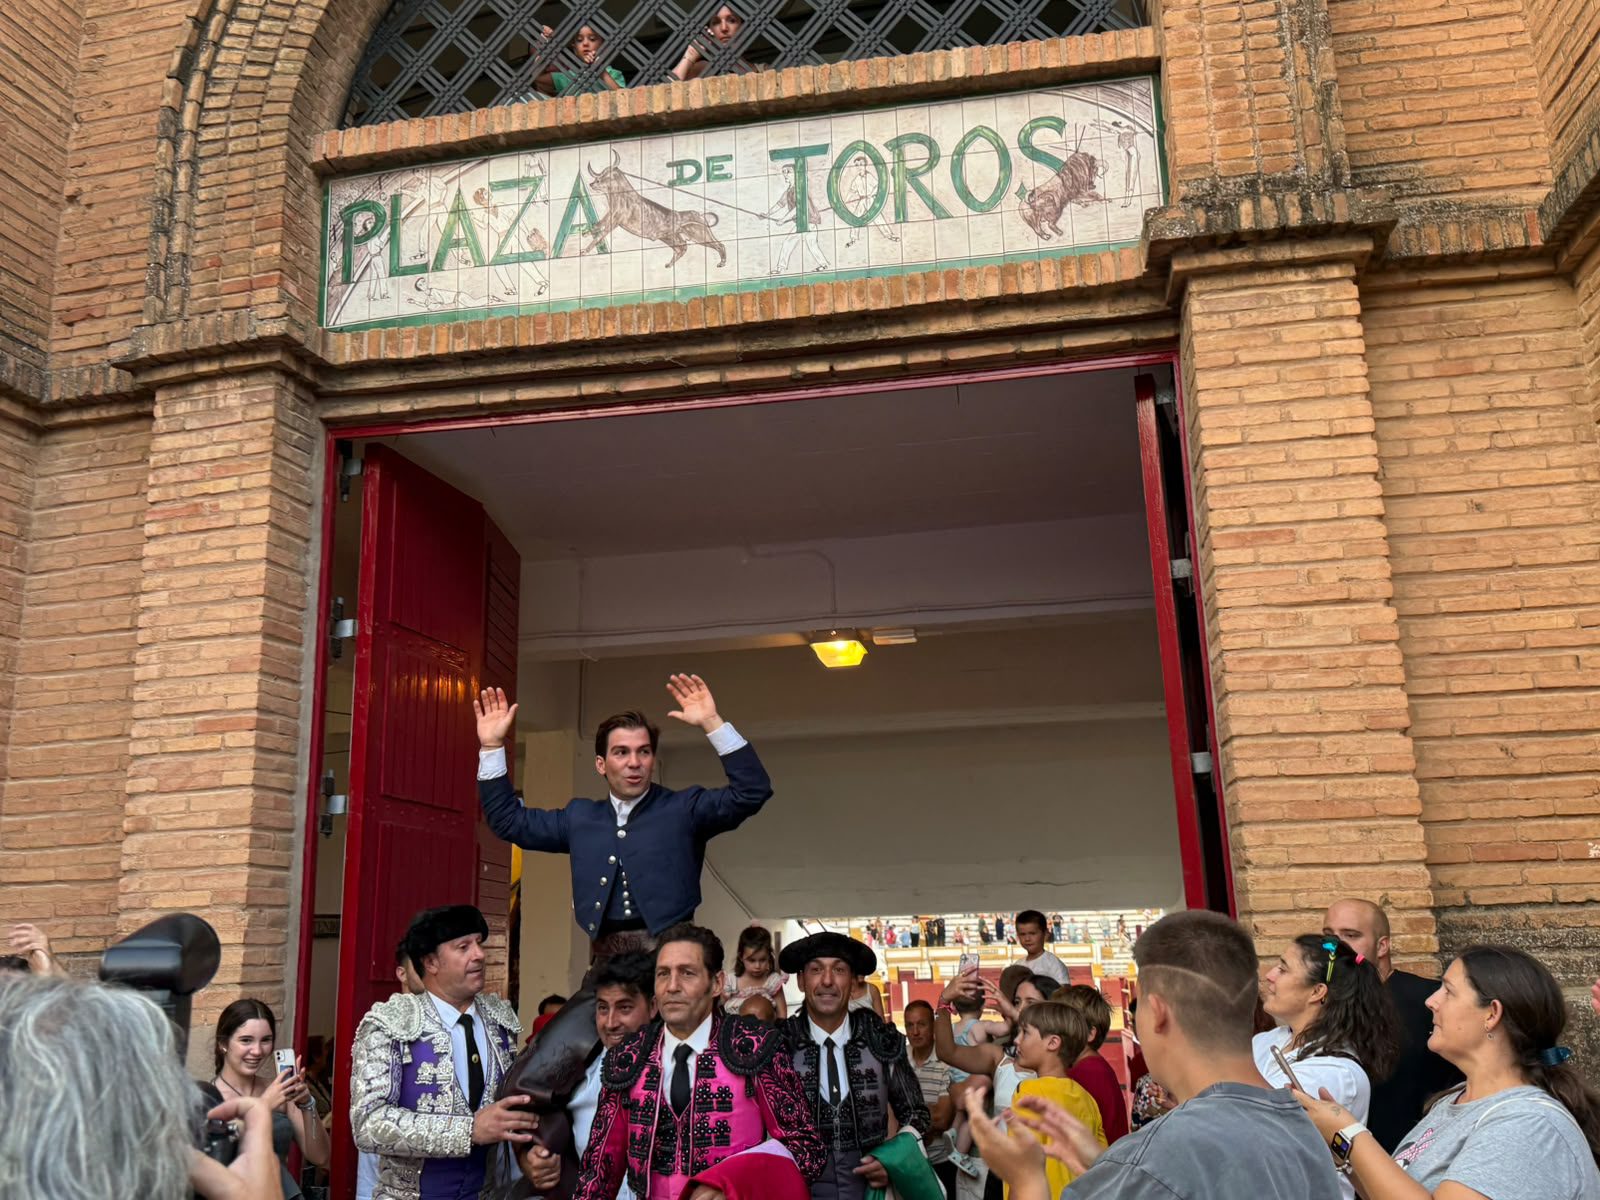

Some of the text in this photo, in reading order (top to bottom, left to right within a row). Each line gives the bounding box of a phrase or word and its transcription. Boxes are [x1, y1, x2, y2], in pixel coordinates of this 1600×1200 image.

[340, 115, 1069, 284] PLAZA DE TOROS
